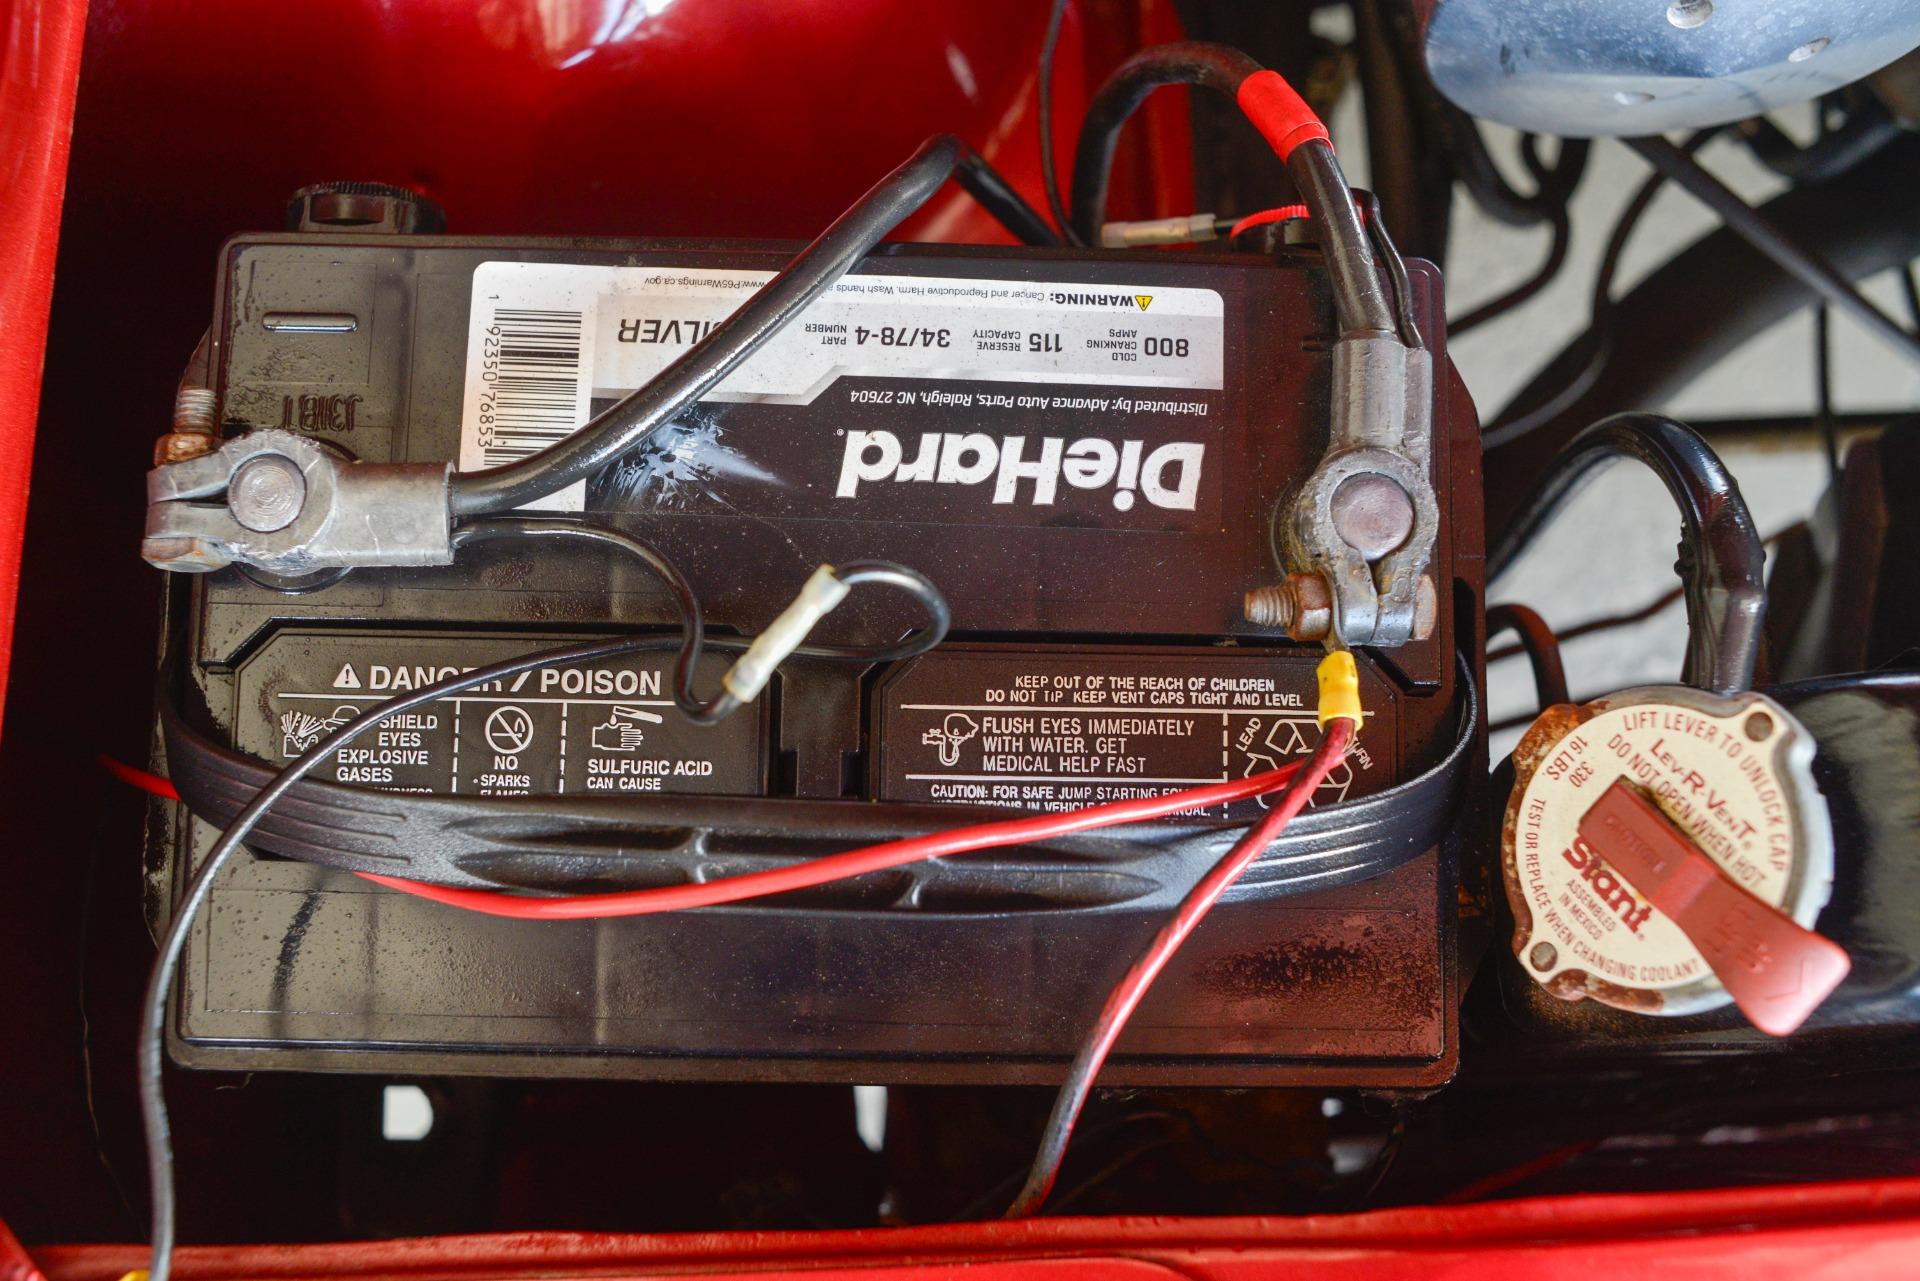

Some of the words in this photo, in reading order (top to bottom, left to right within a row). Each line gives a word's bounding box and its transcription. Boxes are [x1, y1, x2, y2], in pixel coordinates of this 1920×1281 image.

[488, 293, 500, 301] 1
[836, 283, 865, 294] hands
[867, 284, 894, 295] Wash
[896, 285, 925, 296] Harm.
[926, 286, 988, 299] Reproductive
[990, 289, 1009, 299] and
[1011, 290, 1045, 301] Cancer
[1049, 292, 1134, 307] WARNING:
[617, 318, 722, 345] ILVER
[804, 322, 847, 333] NUMBER
[972, 328, 1021, 340] CAPACITY
[1109, 328, 1138, 338] AMPS
[820, 336, 847, 345] PART
[854, 325, 951, 348] 34/78-4
[1028, 333, 1063, 353] 115
[1086, 339, 1137, 350] CRANKING
[482, 326, 501, 382] 92350
[976, 341, 1021, 351] RESERVE
[1144, 337, 1189, 357] 800
[1111, 352, 1137, 361] COLD
[850, 390, 893, 403] 27604
[897, 392, 916, 405] NC
[920, 390, 972, 407] Raleigh,
[976, 393, 1014, 408] Parts,
[1017, 396, 1050, 409] Auto
[1052, 397, 1109, 412] Advance
[1112, 397, 1131, 414] by:
[1134, 399, 1208, 416] Distributed
[477, 391, 496, 447] 76853
[835, 429, 1205, 511] DieHard
[540, 668, 661, 696] POISON
[1015, 675, 1049, 688] KEEP
[1053, 675, 1082, 689] OUT
[1086, 676, 1104, 689] OF
[1109, 676, 1135, 690] THE
[1140, 677, 1183, 690] REACH
[1187, 677, 1206, 690] OF
[1210, 678, 1275, 692] CHILDREN
[985, 689, 1005, 702] DO
[1010, 689, 1037, 703] NOT
[1043, 690, 1064, 703] TIP
[1073, 690, 1107, 704] KEEP
[1111, 691, 1146, 704] VENT
[1150, 692, 1185, 705] CAPS
[1189, 692, 1229, 705] TIGHT
[1232, 693, 1261, 706] AND
[1265, 693, 1304, 707] LEVEL
[379, 714, 438, 729] SHIELD
[982, 716, 1034, 734] FLUSH
[1040, 717, 1082, 735] EYES
[1088, 718, 1195, 736] IMMEDIATELY
[378, 731, 421, 747] EYES
[1234, 717, 1262, 752] LEAD
[982, 735, 1023, 753] WITH
[1030, 736, 1089, 754] WATER.
[1095, 737, 1128, 755] GET
[1568, 735, 1589, 755] 16
[336, 749, 429, 765] EXPLOSIVE
[493, 755, 519, 770] NO
[982, 754, 1053, 772] MEDICAL
[1059, 756, 1101, 774] HELP
[1106, 756, 1147, 774] FAST
[336, 767, 393, 782] GASES
[587, 758, 670, 775] SULFURIC
[673, 760, 713, 776] ACID
[1567, 761, 1595, 788] 330
[480, 774, 531, 788] SPARKS
[586, 776, 613, 790] CAN
[618, 777, 662, 791] CAUSE
[930, 783, 989, 799] CAUTION:
[992, 784, 1019, 799] FOR
[1022, 785, 1055, 800] SAFE
[1058, 786, 1092, 800] JUMP
[1096, 786, 1158, 800] STARTING
[1623, 711, 1657, 732] LIFT
[1664, 713, 1718, 744] LEVER
[1717, 733, 1743, 759] TO
[1738, 754, 1786, 827] UNLOCK
[1767, 832, 1789, 872] CAP
[1526, 798, 1547, 829] TEST
[1607, 733, 1632, 758] DO
[1626, 751, 1661, 786] NOT
[1654, 780, 1696, 821] OPEN
[1690, 817, 1738, 862] WHEN
[1732, 855, 1767, 888] HOT
[1524, 831, 1539, 849] OR
[1525, 852, 1552, 911] REPLACE
[1566, 879, 1619, 933] ASSEMBLED
[1558, 891, 1570, 908] IN
[1569, 903, 1605, 942] MEXICO
[1543, 908, 1576, 947] WHEN
[1572, 939, 1638, 982] CHANGING
[1639, 957, 1700, 983] COOLANT
